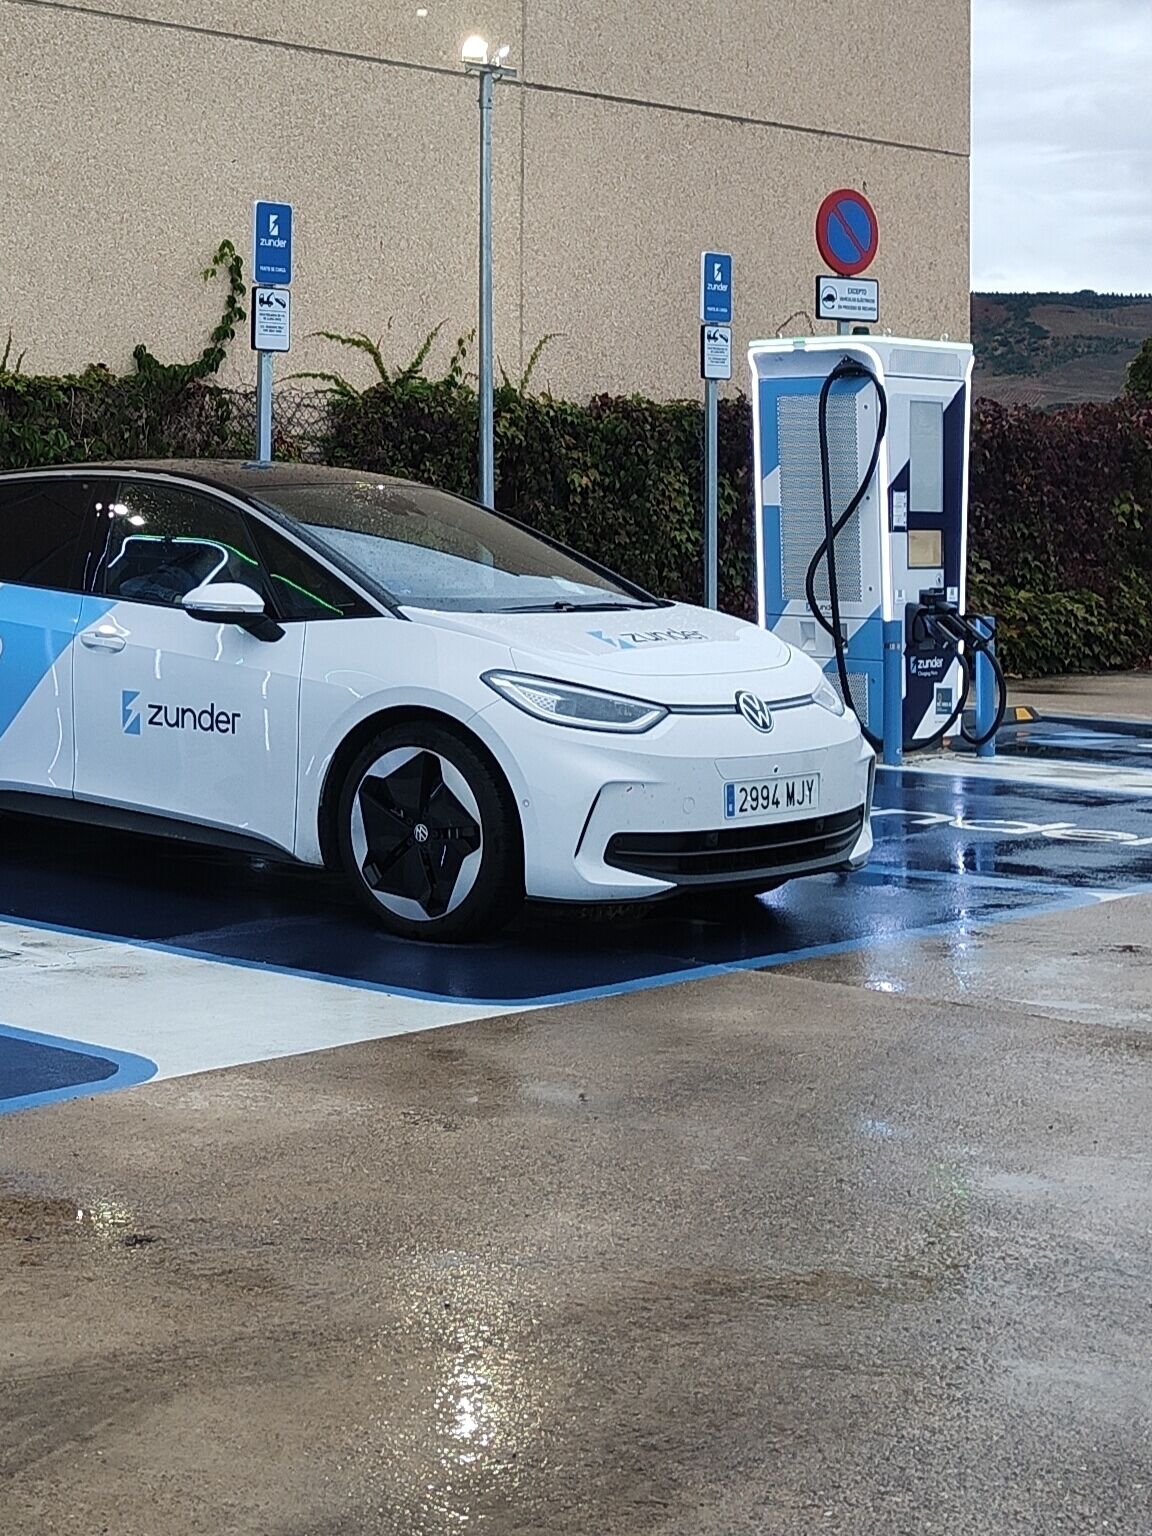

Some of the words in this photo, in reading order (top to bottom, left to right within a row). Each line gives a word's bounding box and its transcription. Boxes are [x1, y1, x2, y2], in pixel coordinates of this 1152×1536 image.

[260, 238, 287, 248] zunder
[707, 282, 728, 292] zunder
[847, 287, 867, 295] EXCEPTO
[620, 628, 709, 643] zunder
[918, 656, 944, 669] zunder
[148, 703, 241, 734] zunder
[739, 784, 780, 813] 2994
[786, 779, 814, 807] MJY
